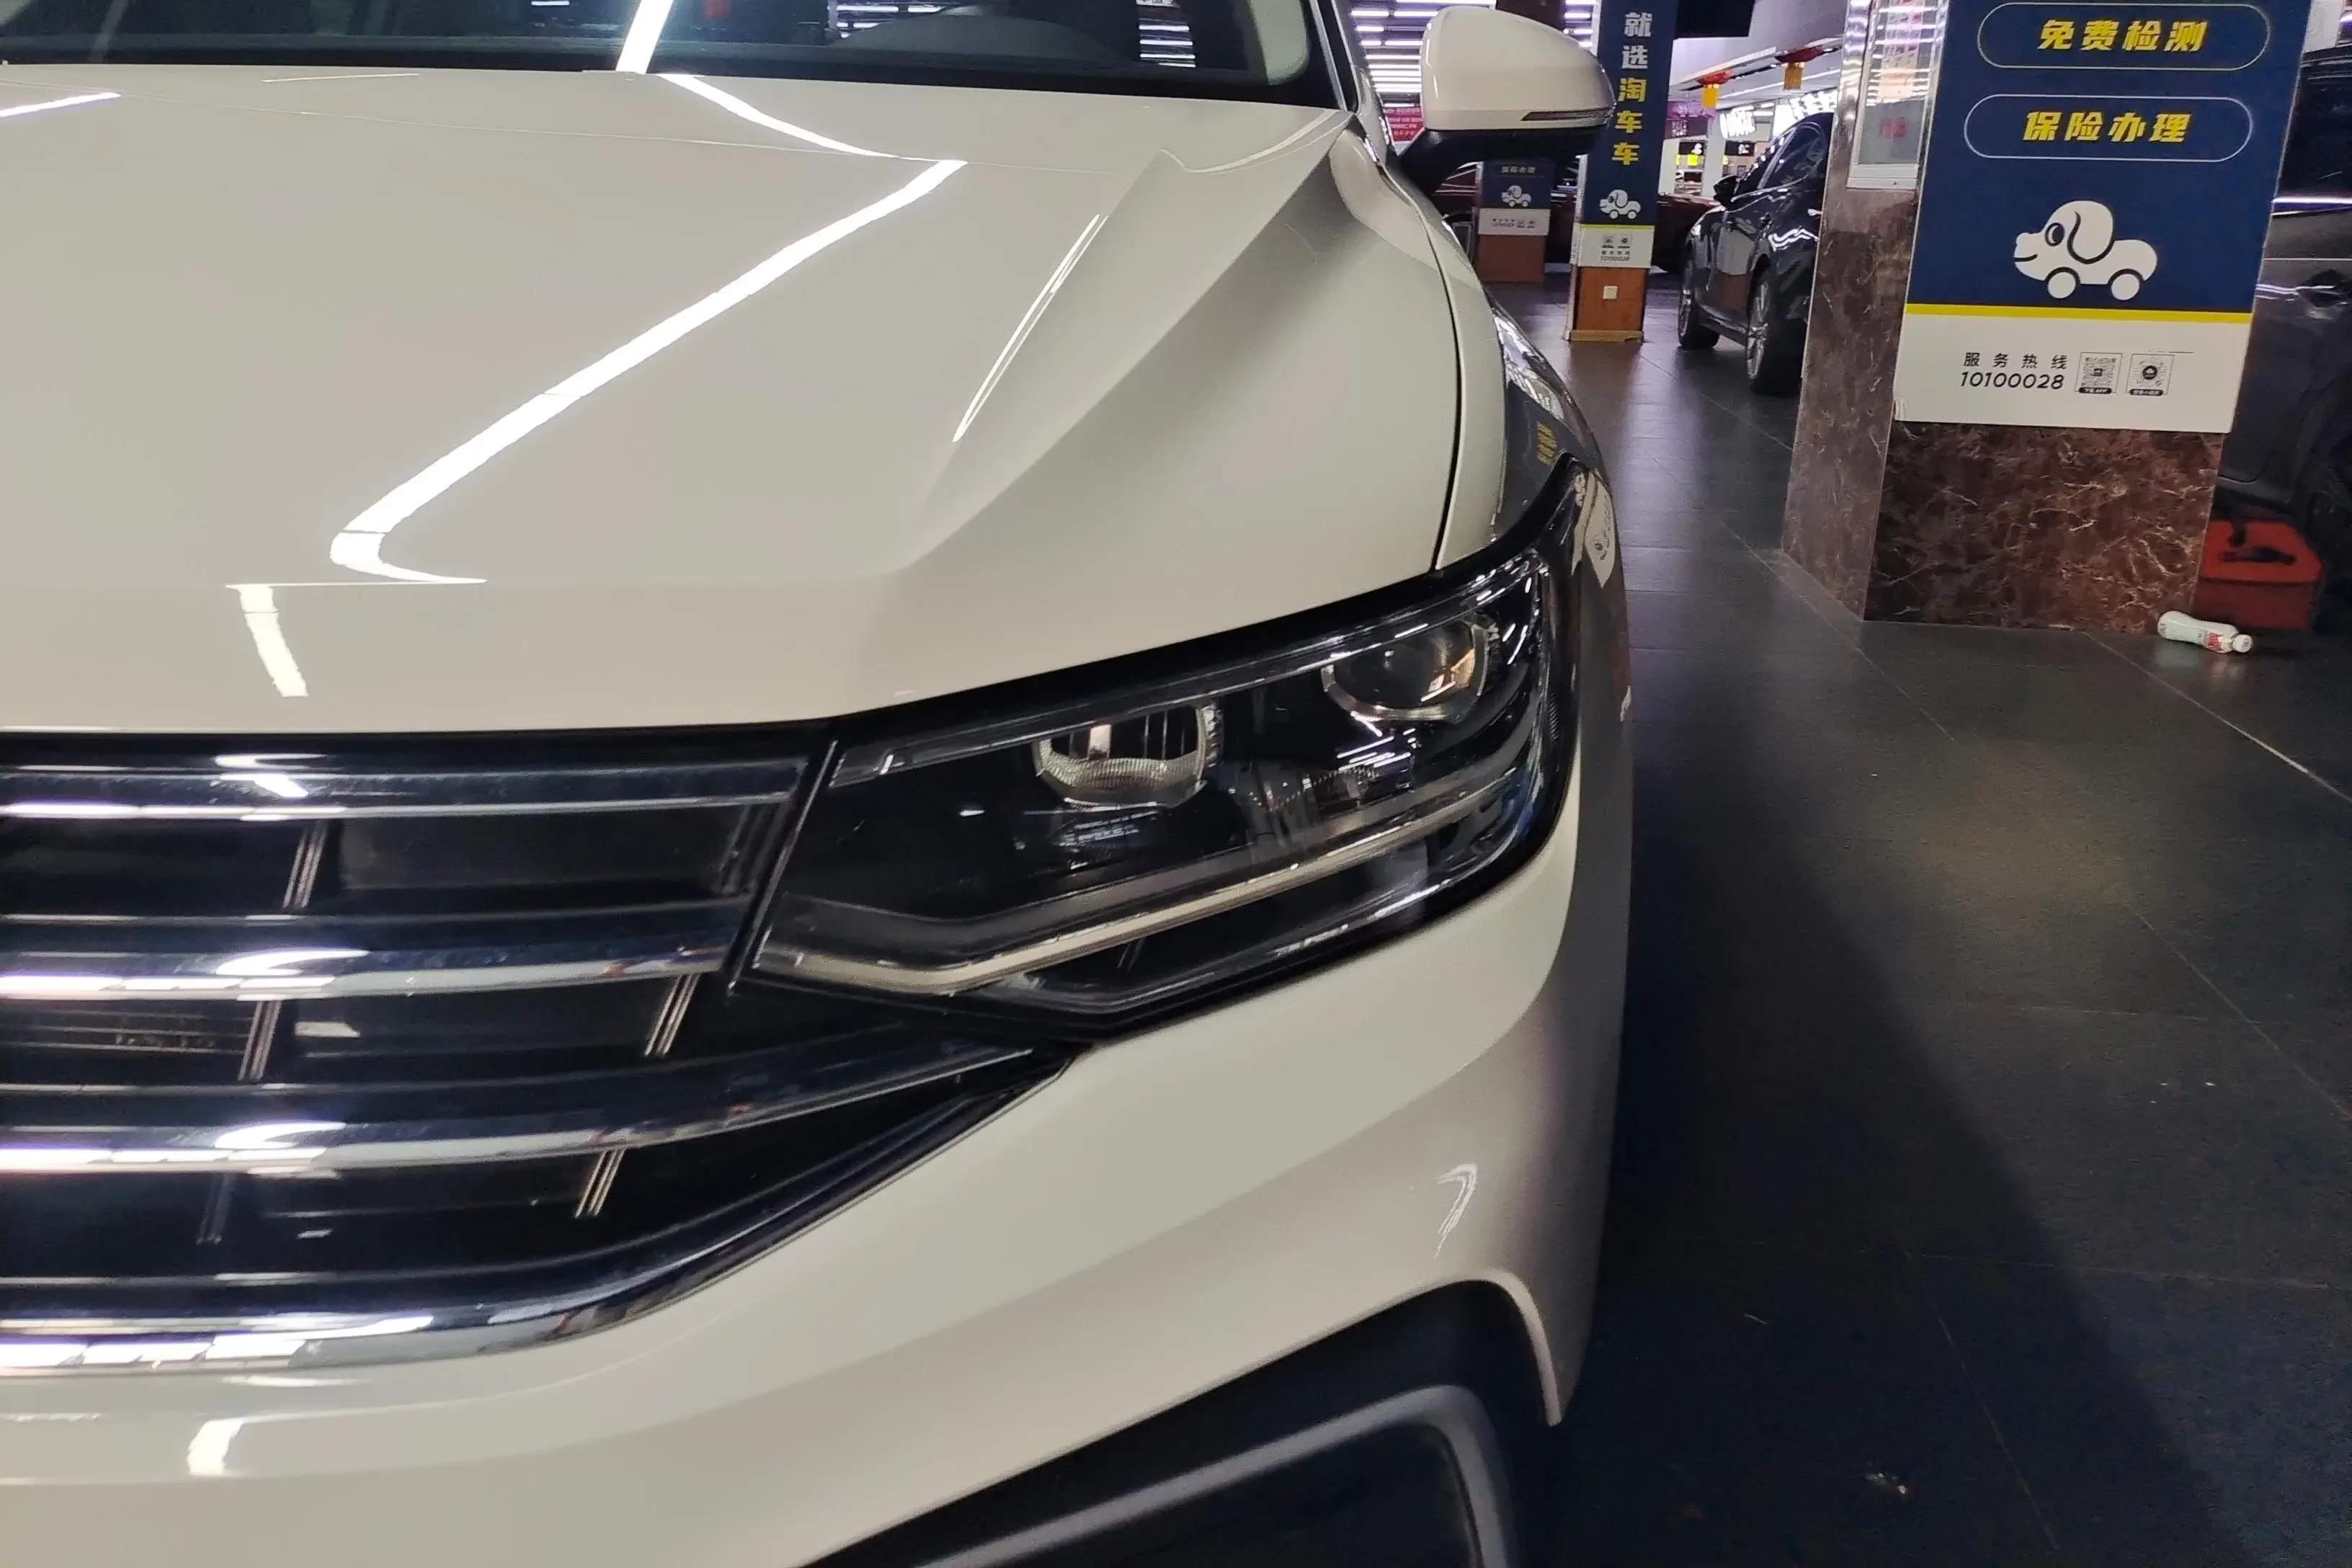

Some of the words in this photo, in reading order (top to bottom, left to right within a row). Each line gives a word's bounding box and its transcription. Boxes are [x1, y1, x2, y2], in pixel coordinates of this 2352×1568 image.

[2037, 19, 2208, 52] 免费检测
[1611, 12, 1652, 165] 就选淘车车
[2023, 111, 2192, 142] 保险办理
[1963, 352, 2068, 370] 服务热线
[1960, 371, 2064, 390] 10100028
